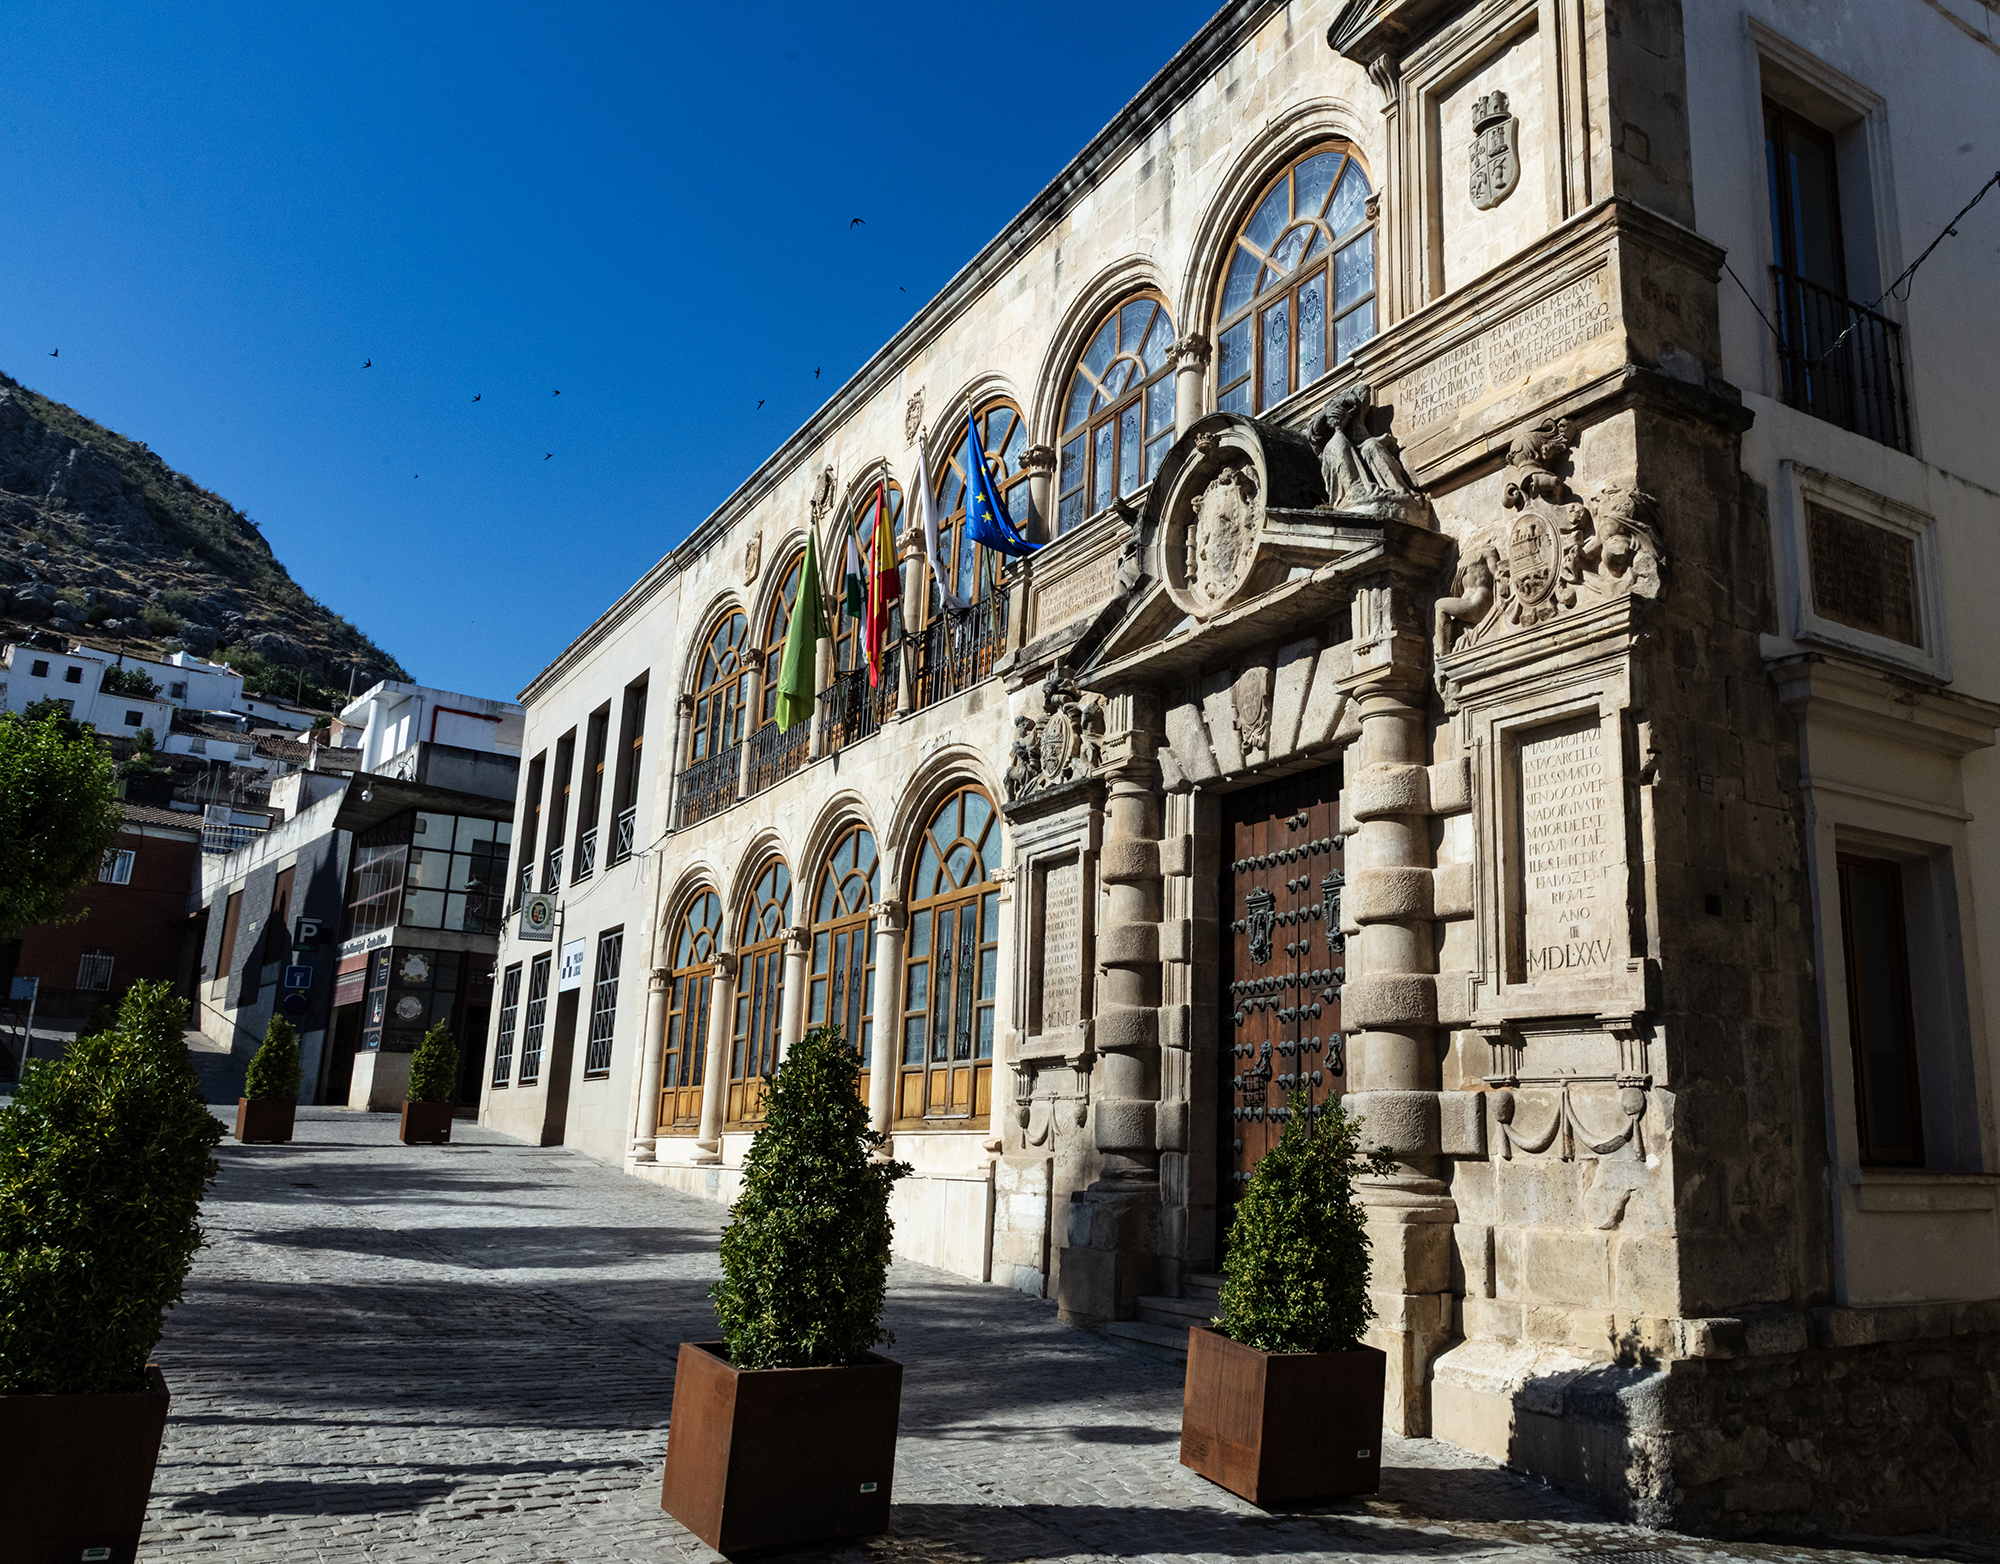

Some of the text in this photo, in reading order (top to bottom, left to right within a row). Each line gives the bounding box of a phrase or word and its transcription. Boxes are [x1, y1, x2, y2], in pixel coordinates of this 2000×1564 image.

[1438, 336, 1482, 370] MISERERE
[1558, 906, 1591, 923] ANO
[299, 923, 318, 943] P
